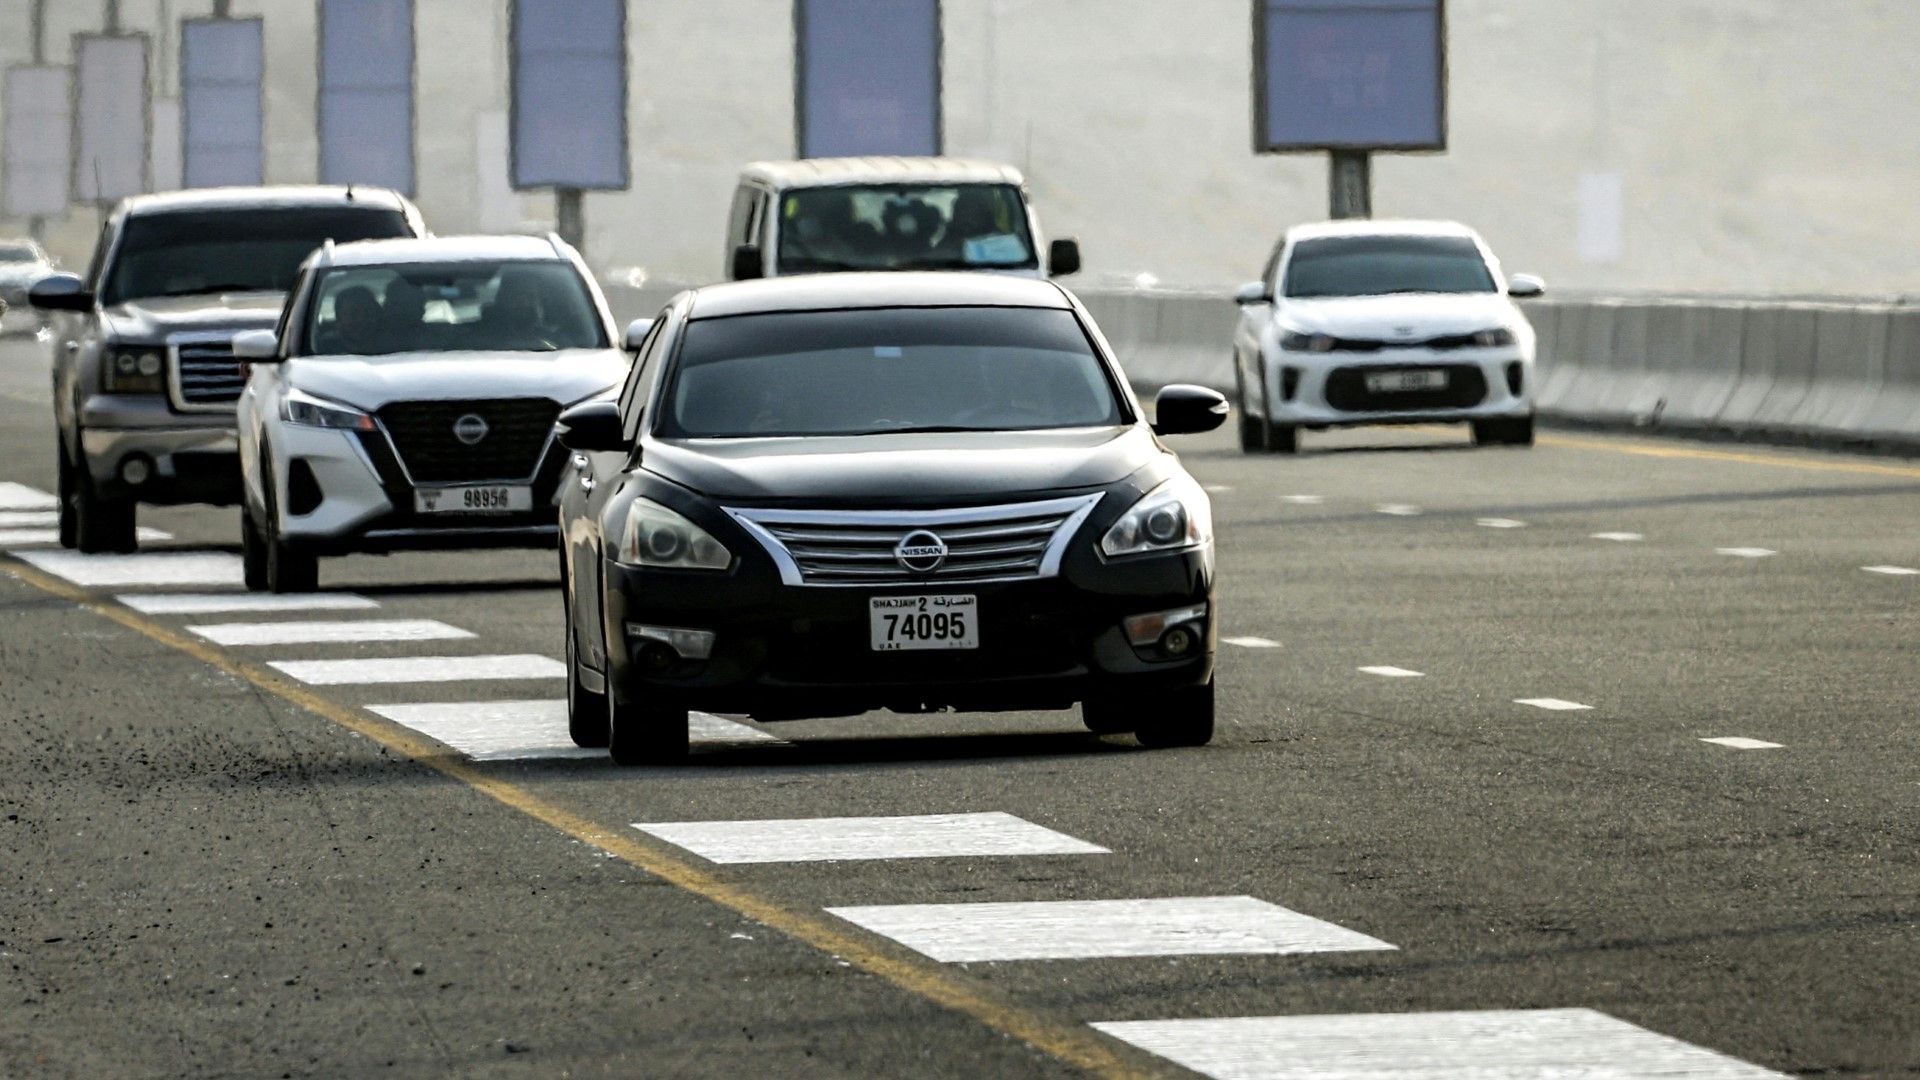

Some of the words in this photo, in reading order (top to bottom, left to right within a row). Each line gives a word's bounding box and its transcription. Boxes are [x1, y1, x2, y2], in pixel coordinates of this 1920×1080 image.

[901, 547, 942, 556] NISSAN
[918, 597, 927, 612] 2
[883, 612, 965, 641] 74095
